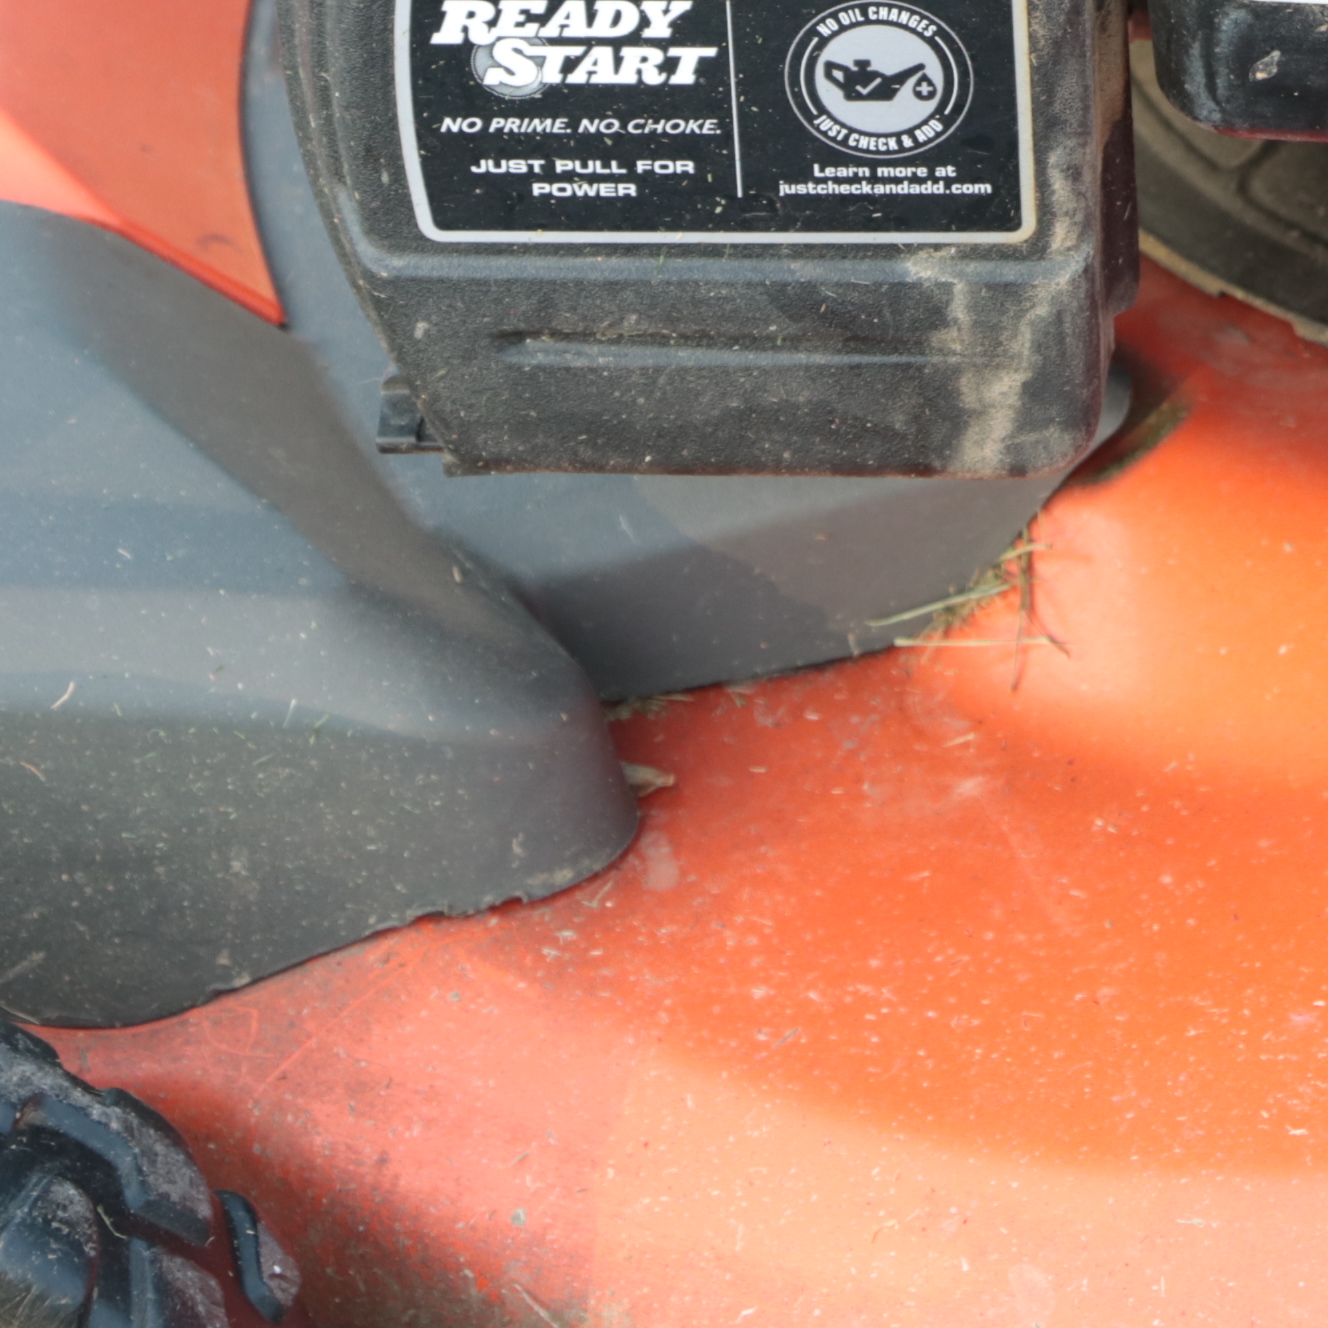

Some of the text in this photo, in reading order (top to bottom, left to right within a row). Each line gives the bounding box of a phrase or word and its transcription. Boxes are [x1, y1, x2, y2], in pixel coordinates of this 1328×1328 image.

[430, 0, 693, 46] READY
[816, 6, 937, 37] NO OIL CHANGES
[483, 38, 718, 86] START
[440, 118, 721, 134] NO PRIME. NO CHOKE.
[814, 115, 848, 140] JUST
[848, 133, 898, 151] CHECK
[901, 134, 914, 148] &
[470, 160, 694, 174] JUST PULL FOR
[813, 164, 956, 177] Learn more at
[532, 183, 637, 196] POWER
[779, 180, 992, 196] justcheckandadd.com
